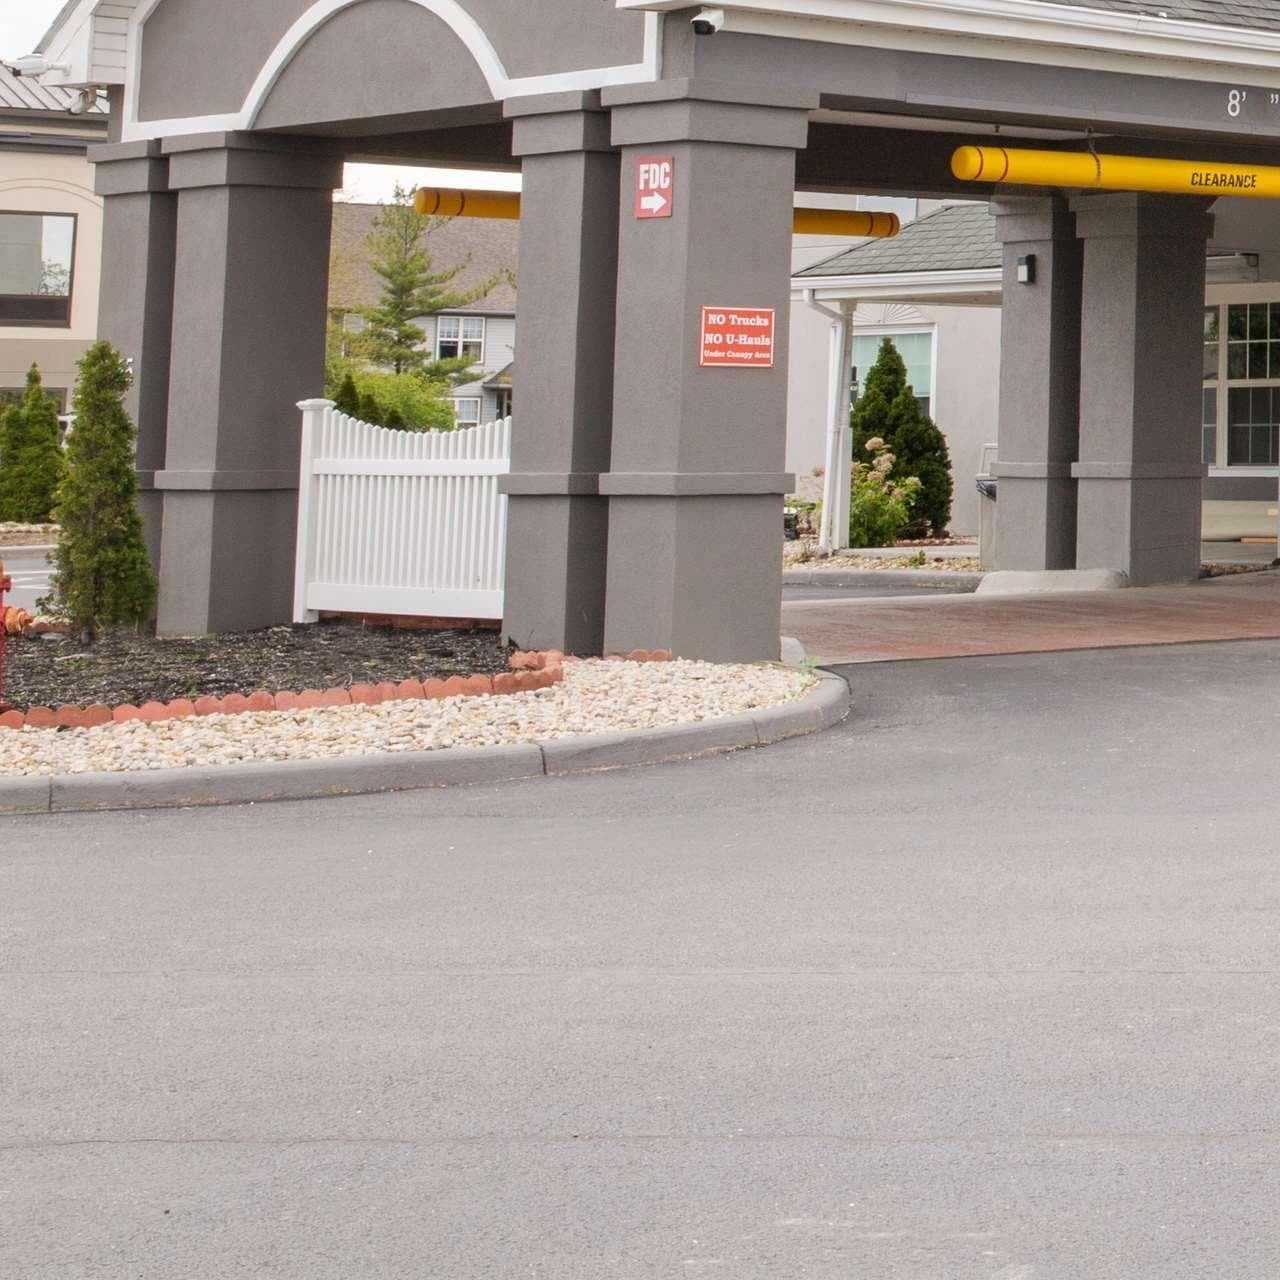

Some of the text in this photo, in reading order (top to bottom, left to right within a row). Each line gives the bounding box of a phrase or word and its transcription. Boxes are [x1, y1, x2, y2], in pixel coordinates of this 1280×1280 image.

[639, 161, 671, 191] FDC
[1191, 172, 1257, 189] CLEARANCE
[708, 314, 769, 326] NO Trucks
[704, 333, 771, 345] NO U-Hauls
